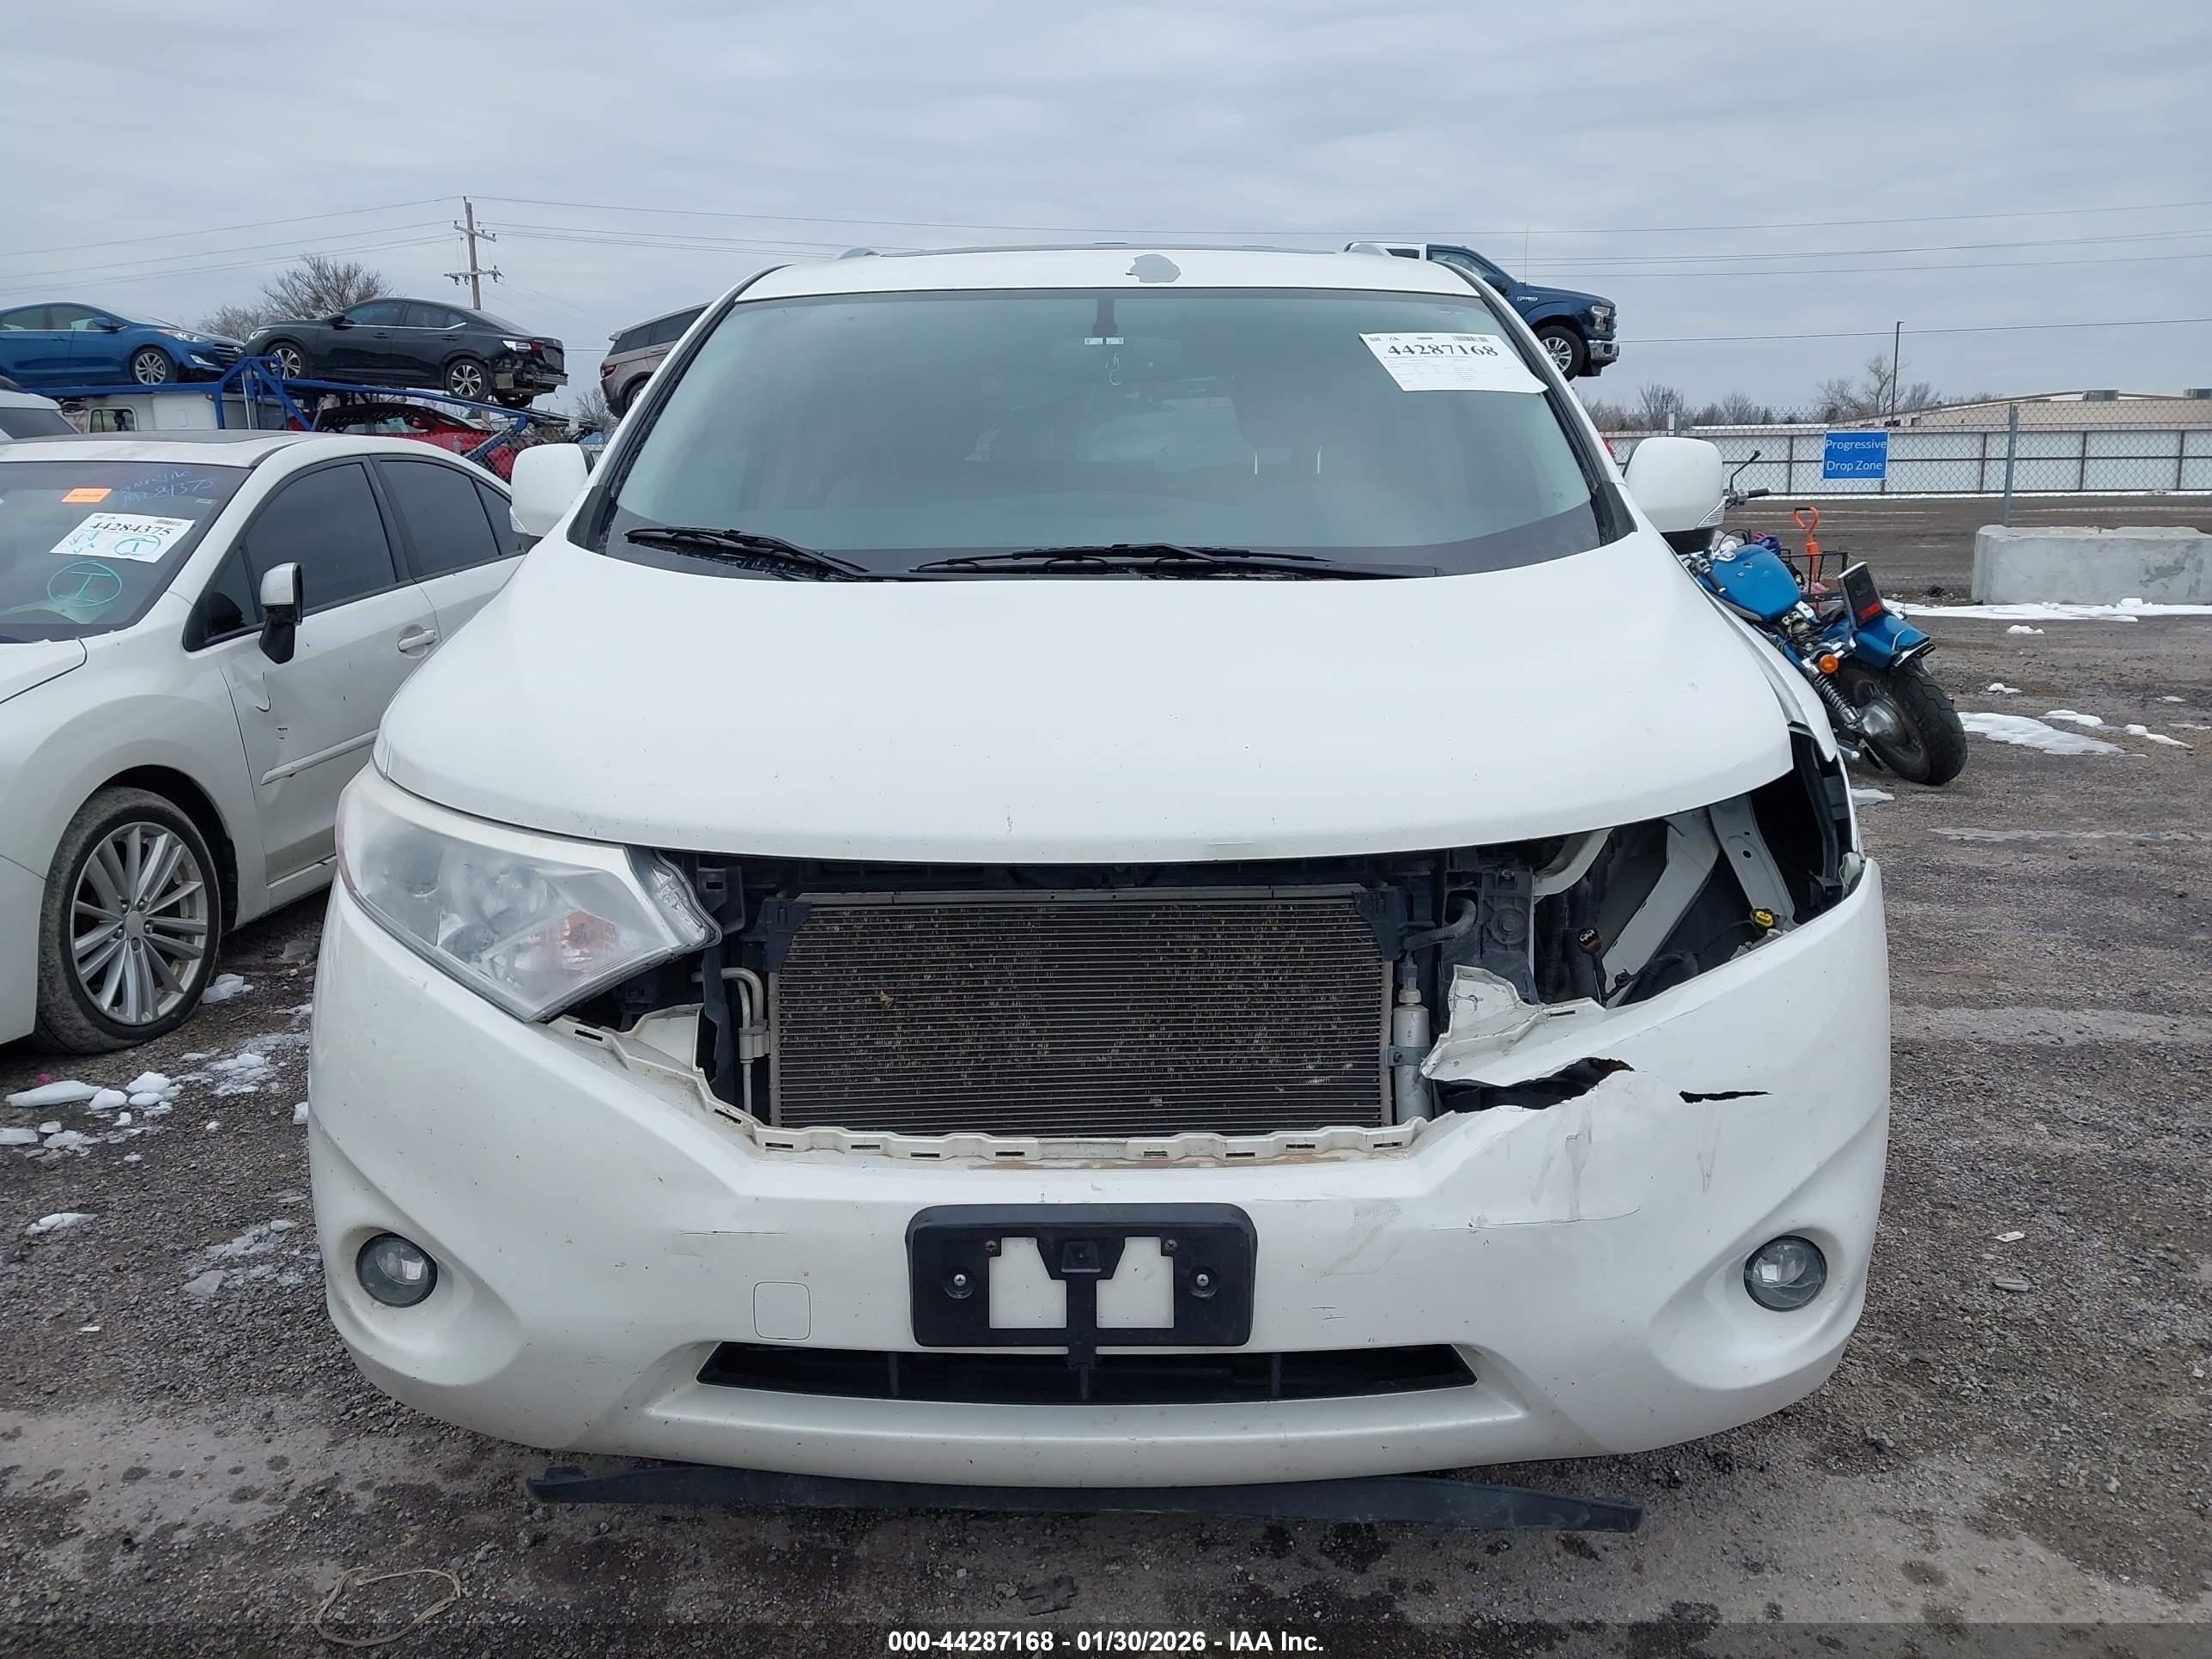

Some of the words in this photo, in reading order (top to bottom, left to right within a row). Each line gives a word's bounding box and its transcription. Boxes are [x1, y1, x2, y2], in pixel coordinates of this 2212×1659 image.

[1388, 344, 1498, 356] 44287168
[1826, 439, 1887, 451] Progressive
[1827, 460, 1853, 472] Drop
[1856, 460, 1882, 471] Zone
[89, 521, 173, 537] 44284375
